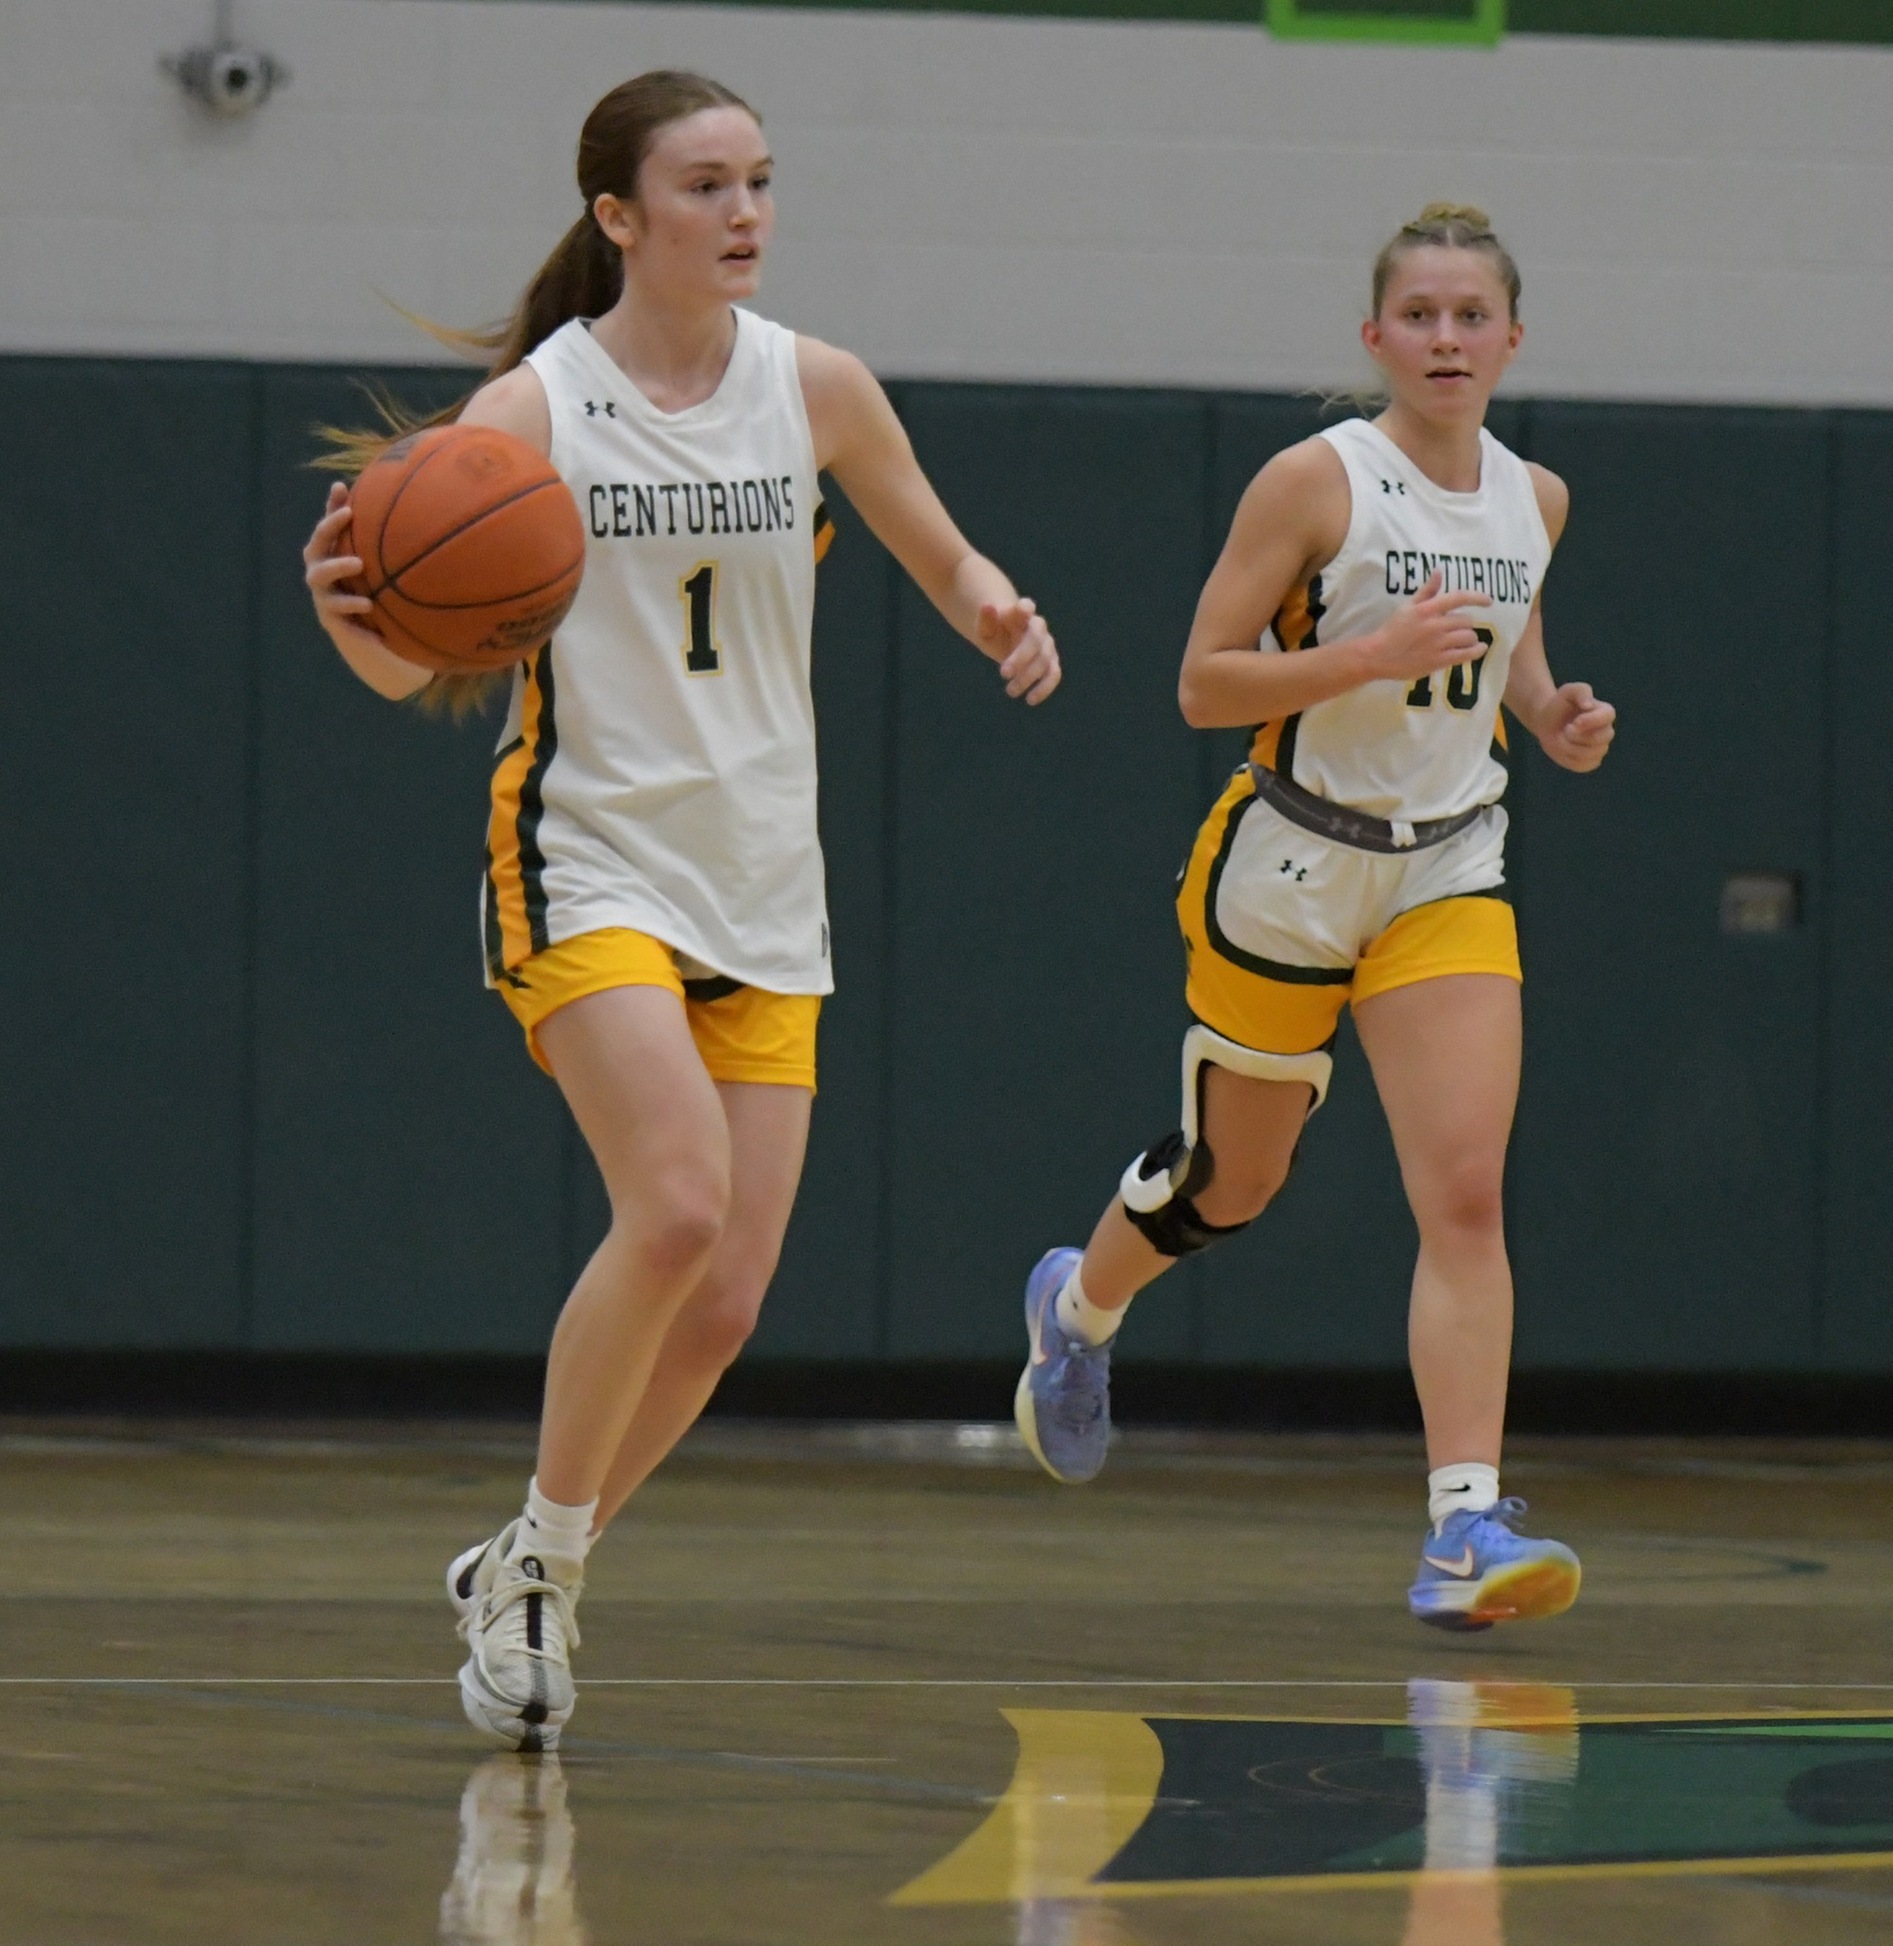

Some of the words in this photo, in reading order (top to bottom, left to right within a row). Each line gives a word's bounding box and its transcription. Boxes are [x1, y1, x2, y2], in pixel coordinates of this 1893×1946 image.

[589, 476, 795, 538] CENTURIONS
[1385, 550, 1532, 604] CENTURIONS
[679, 561, 723, 677] 1
